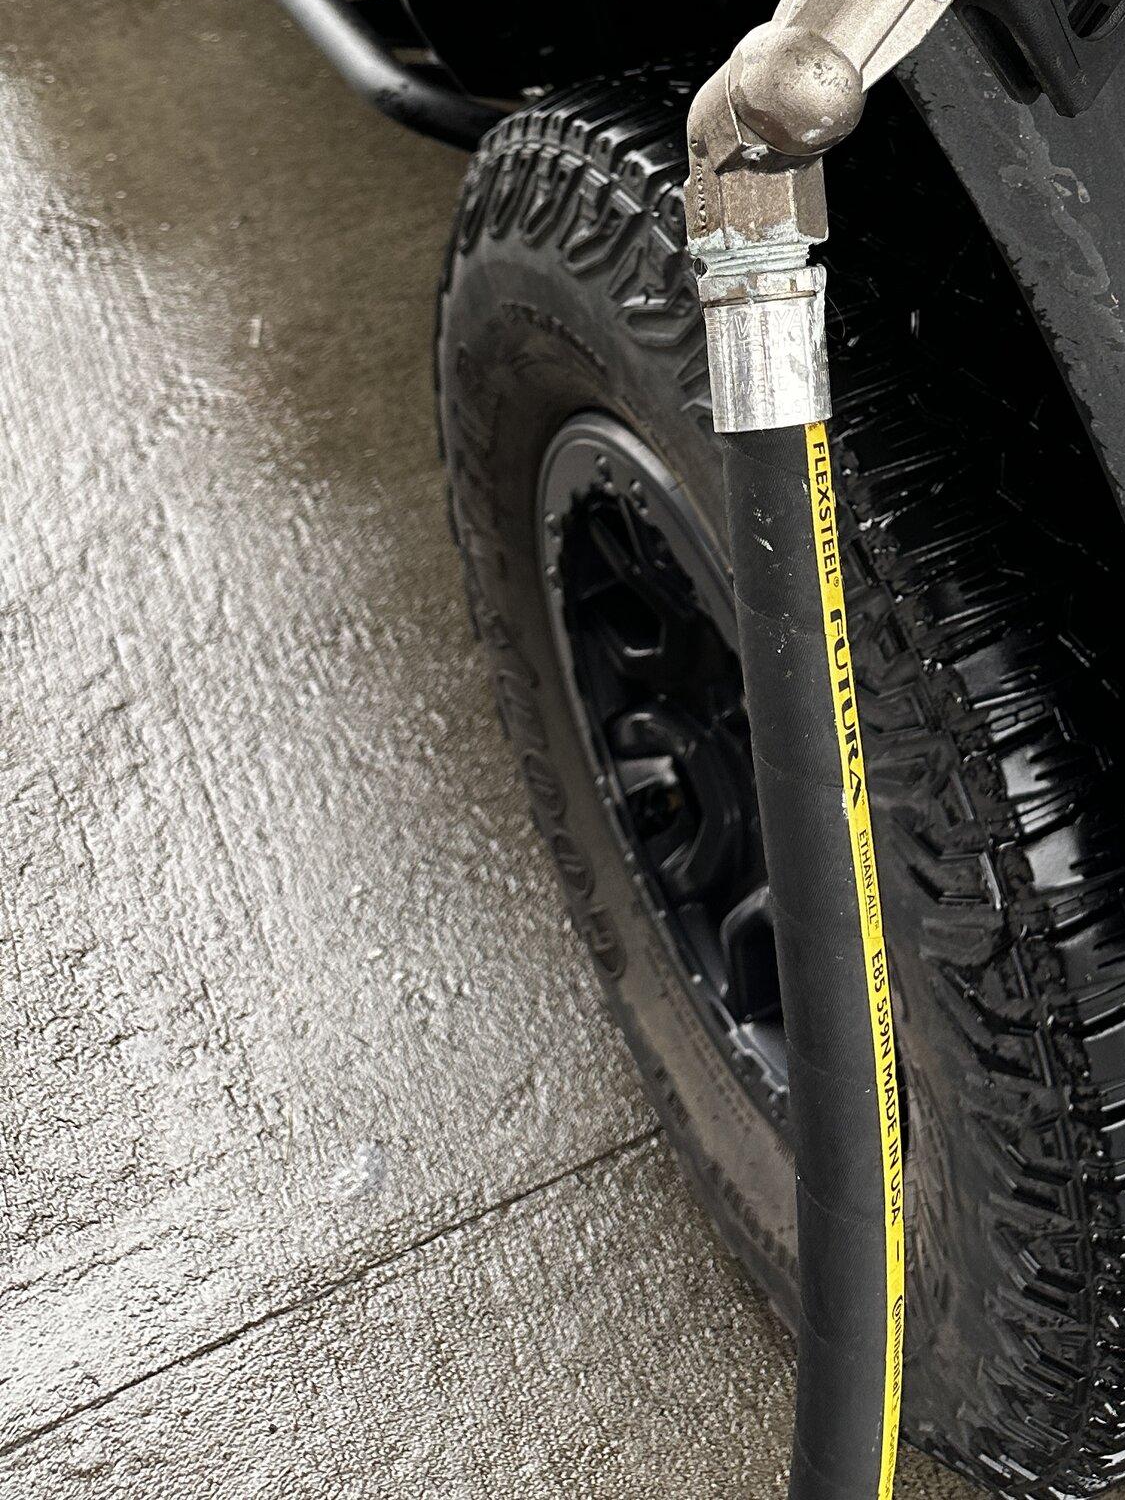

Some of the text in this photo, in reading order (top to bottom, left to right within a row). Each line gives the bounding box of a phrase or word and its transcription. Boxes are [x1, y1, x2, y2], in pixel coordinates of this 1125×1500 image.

[872, 948, 885, 993] E85
[876, 999, 893, 1060] 559N
[882, 1060, 898, 1138] MADE
[888, 1140, 900, 1171] IN
[890, 1174, 902, 1228] USA
